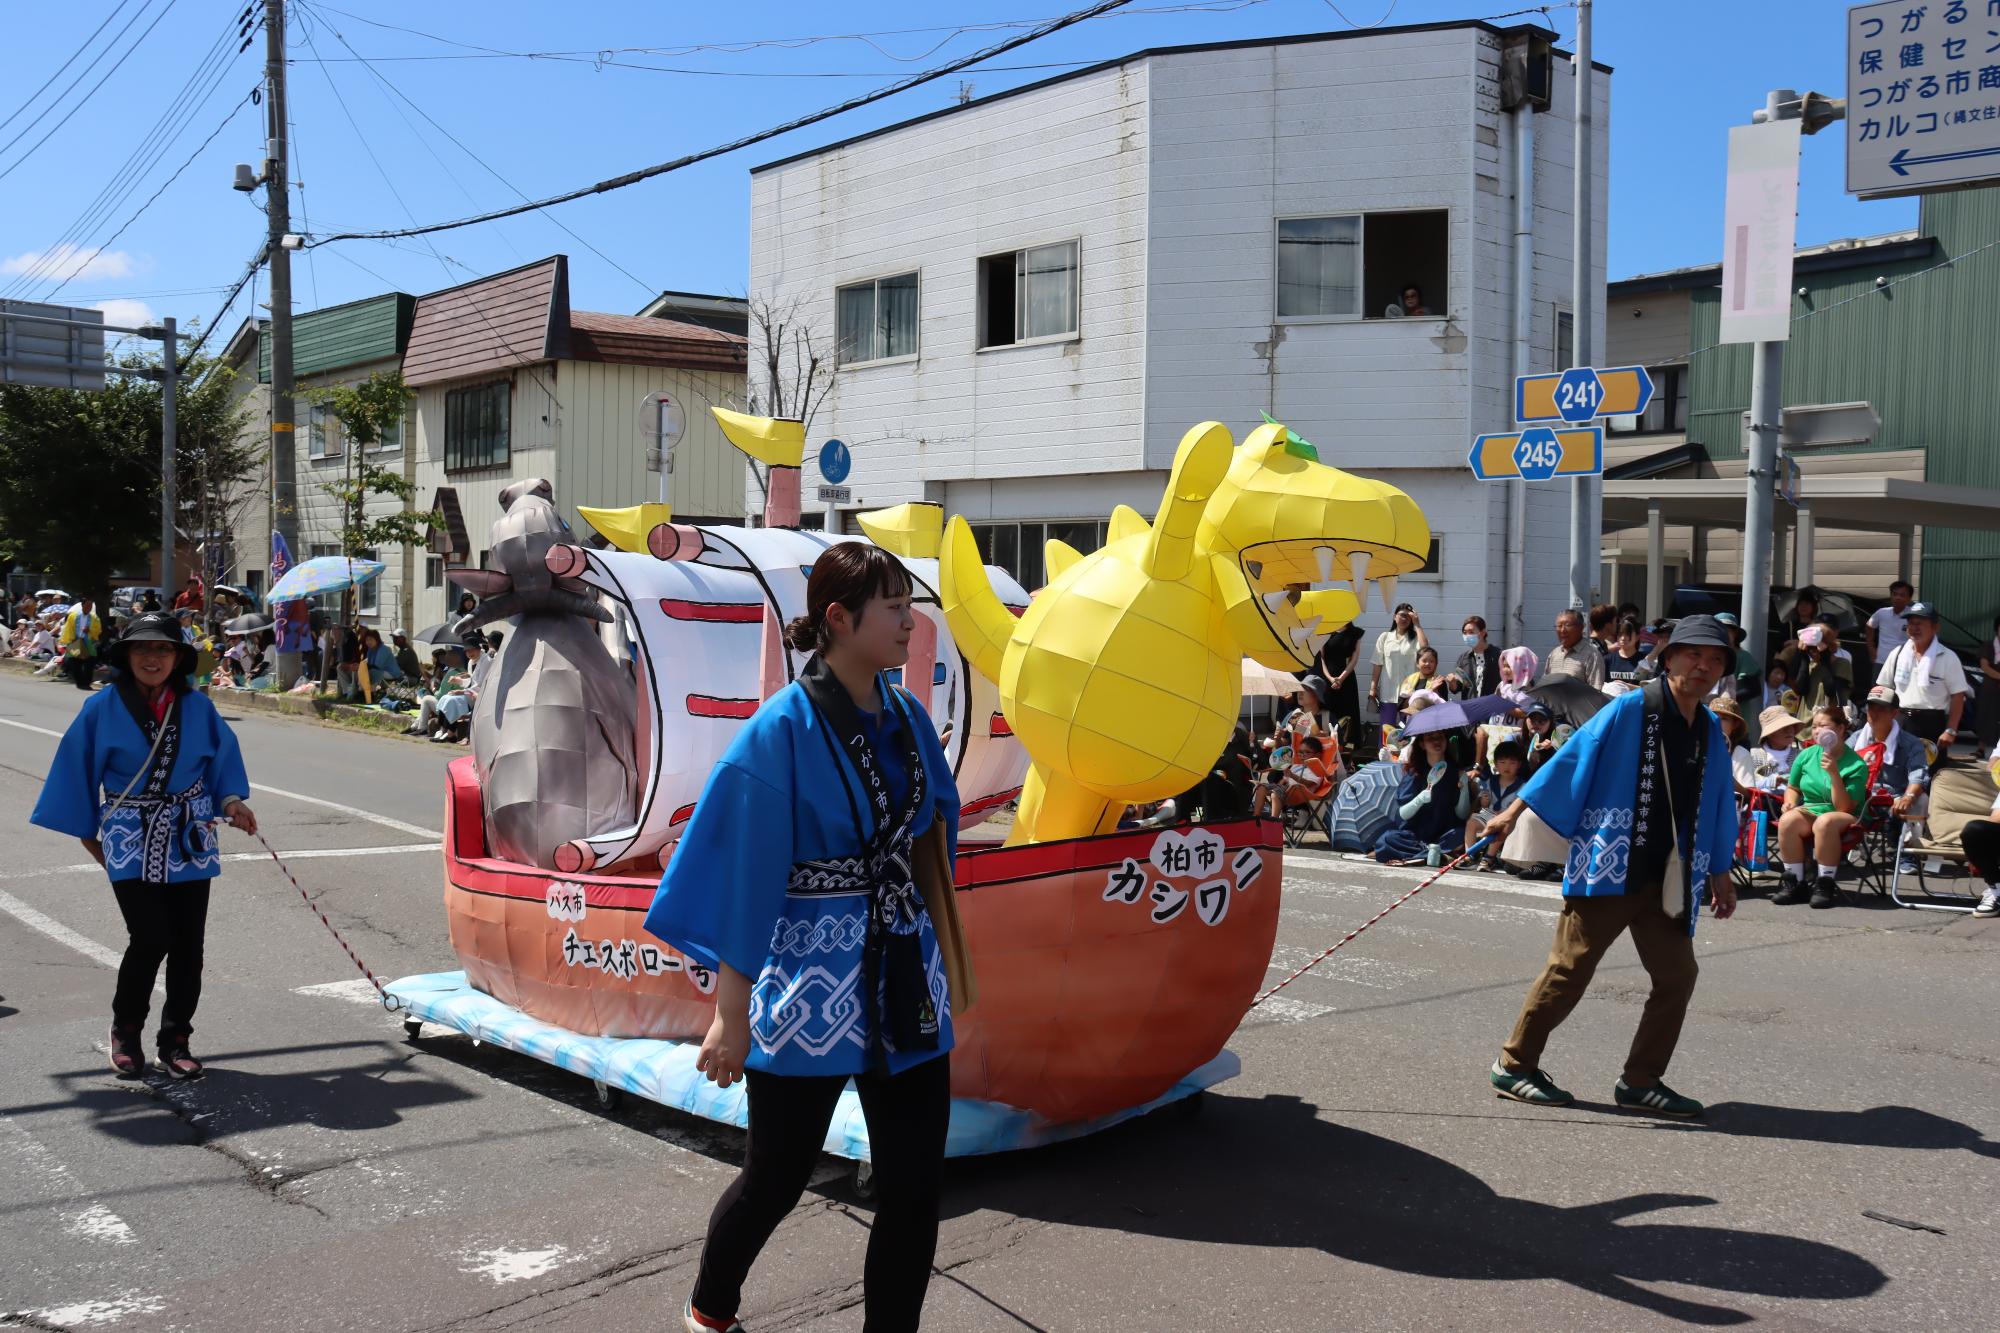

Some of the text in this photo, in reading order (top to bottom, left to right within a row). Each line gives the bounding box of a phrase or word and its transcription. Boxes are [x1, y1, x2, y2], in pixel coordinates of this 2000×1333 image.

[1561, 380, 1597, 410] 241
[1520, 440, 1557, 468] 245
[1634, 713, 1659, 847] つがる市姉妹都市協会
[1161, 840, 1218, 873] 柏市
